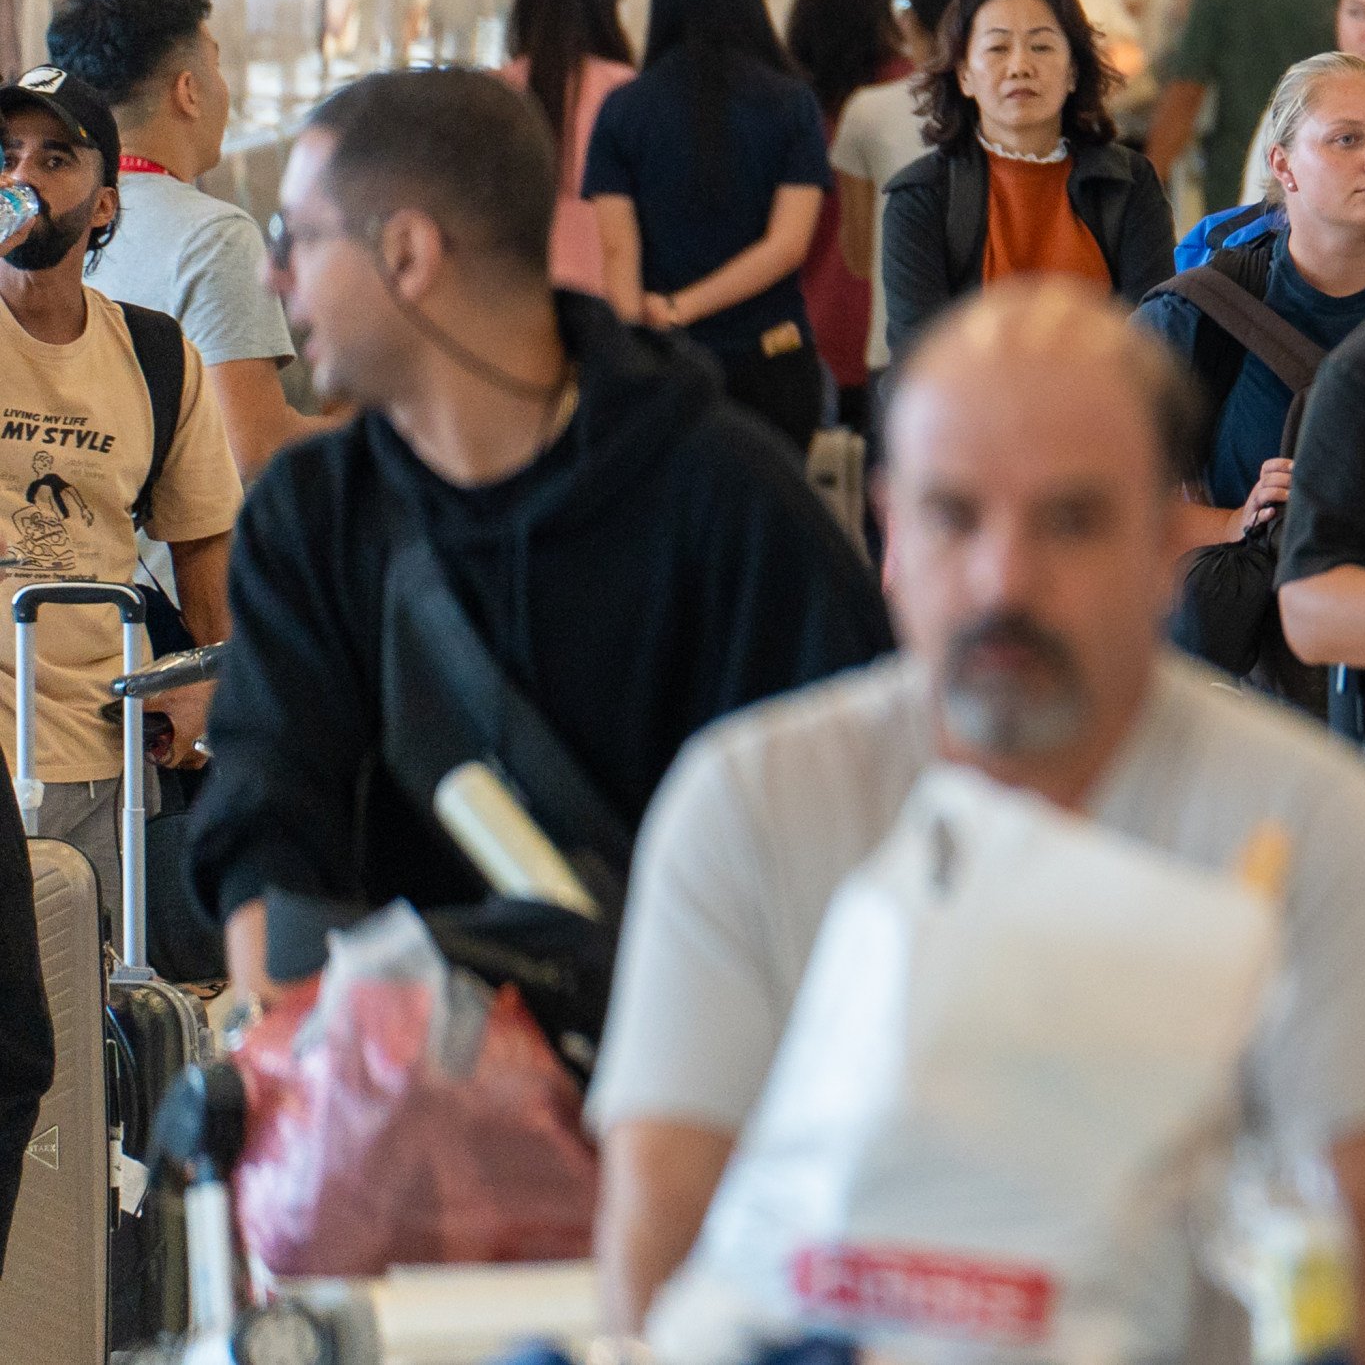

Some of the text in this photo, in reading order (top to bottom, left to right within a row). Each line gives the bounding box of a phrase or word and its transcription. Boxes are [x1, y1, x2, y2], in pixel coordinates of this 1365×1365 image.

[3, 408, 88, 427] LIVING MY LIFE
[1, 421, 116, 454] MY STYLE
